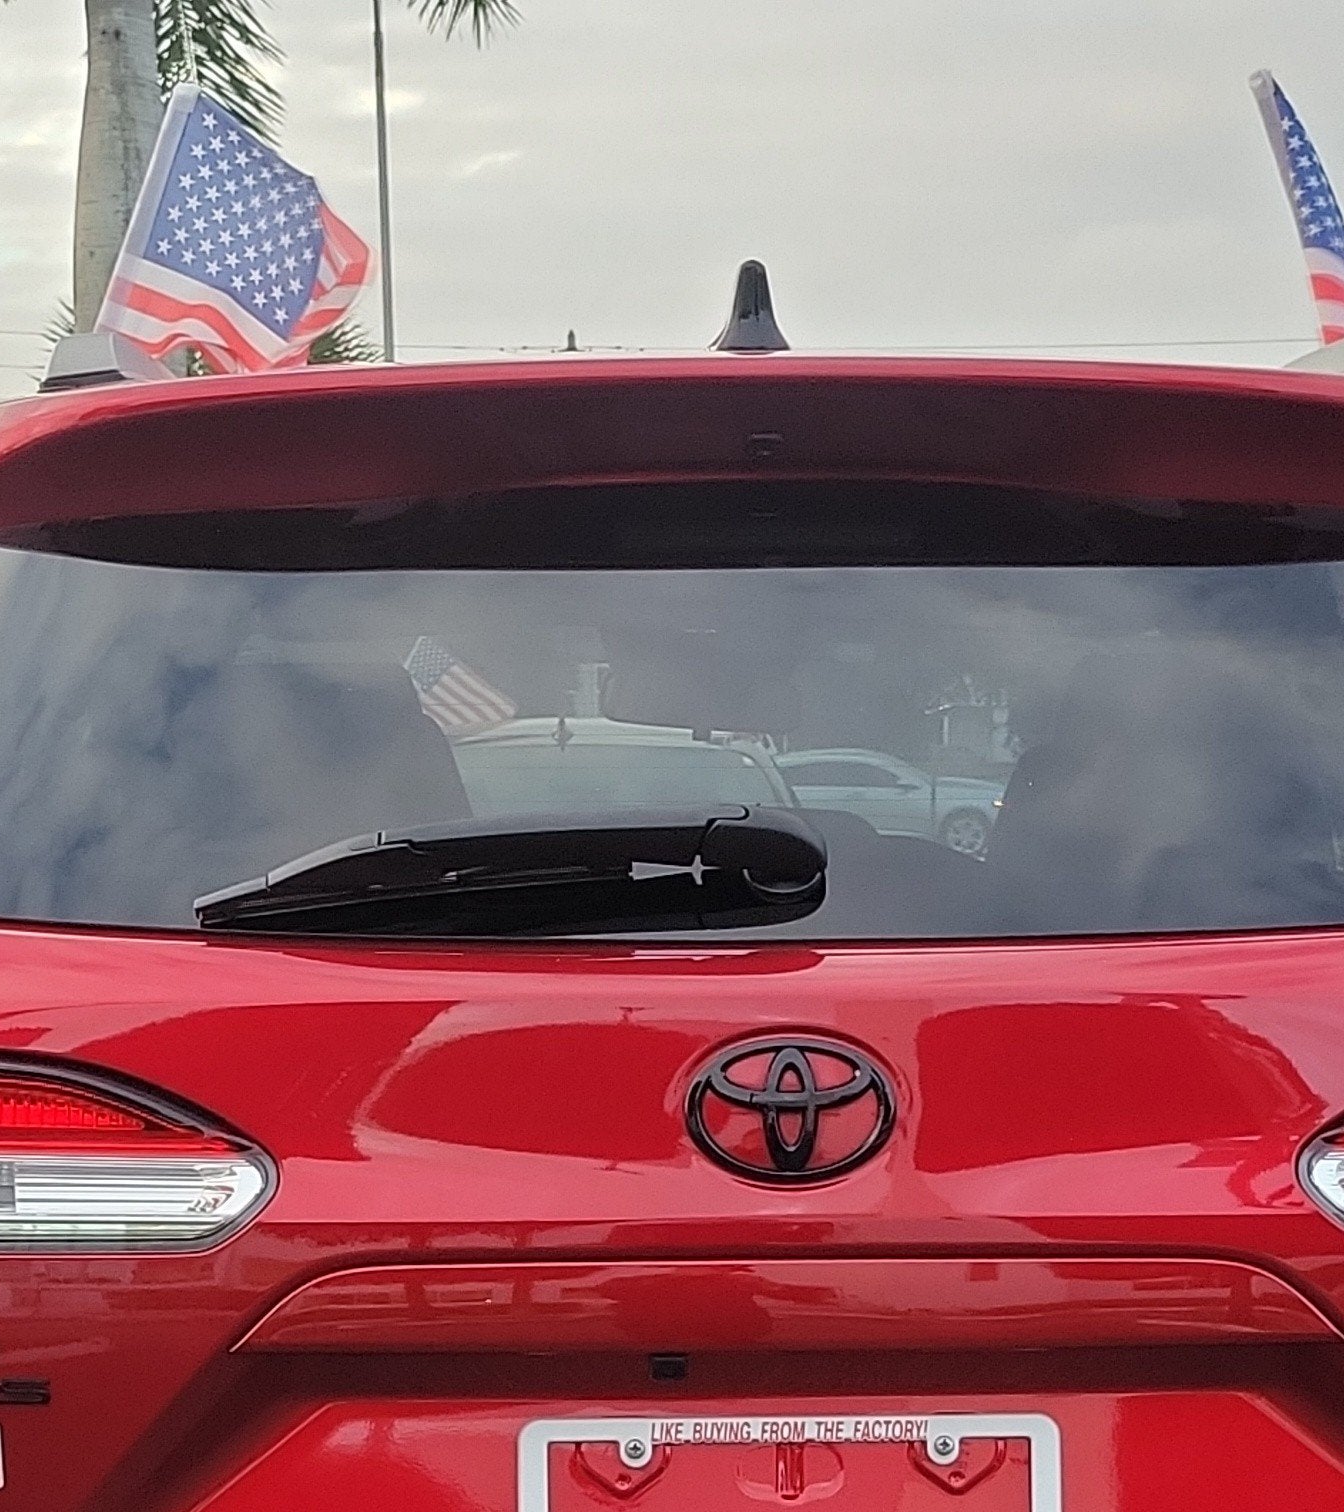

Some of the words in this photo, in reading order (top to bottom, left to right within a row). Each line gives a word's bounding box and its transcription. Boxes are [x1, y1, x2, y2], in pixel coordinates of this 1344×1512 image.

[651, 1422, 683, 1442] LIKE
[692, 1422, 751, 1441] BUYING
[760, 1421, 805, 1440] FROM
[815, 1421, 844, 1440] THE
[855, 1420, 928, 1440] FACTORY!
